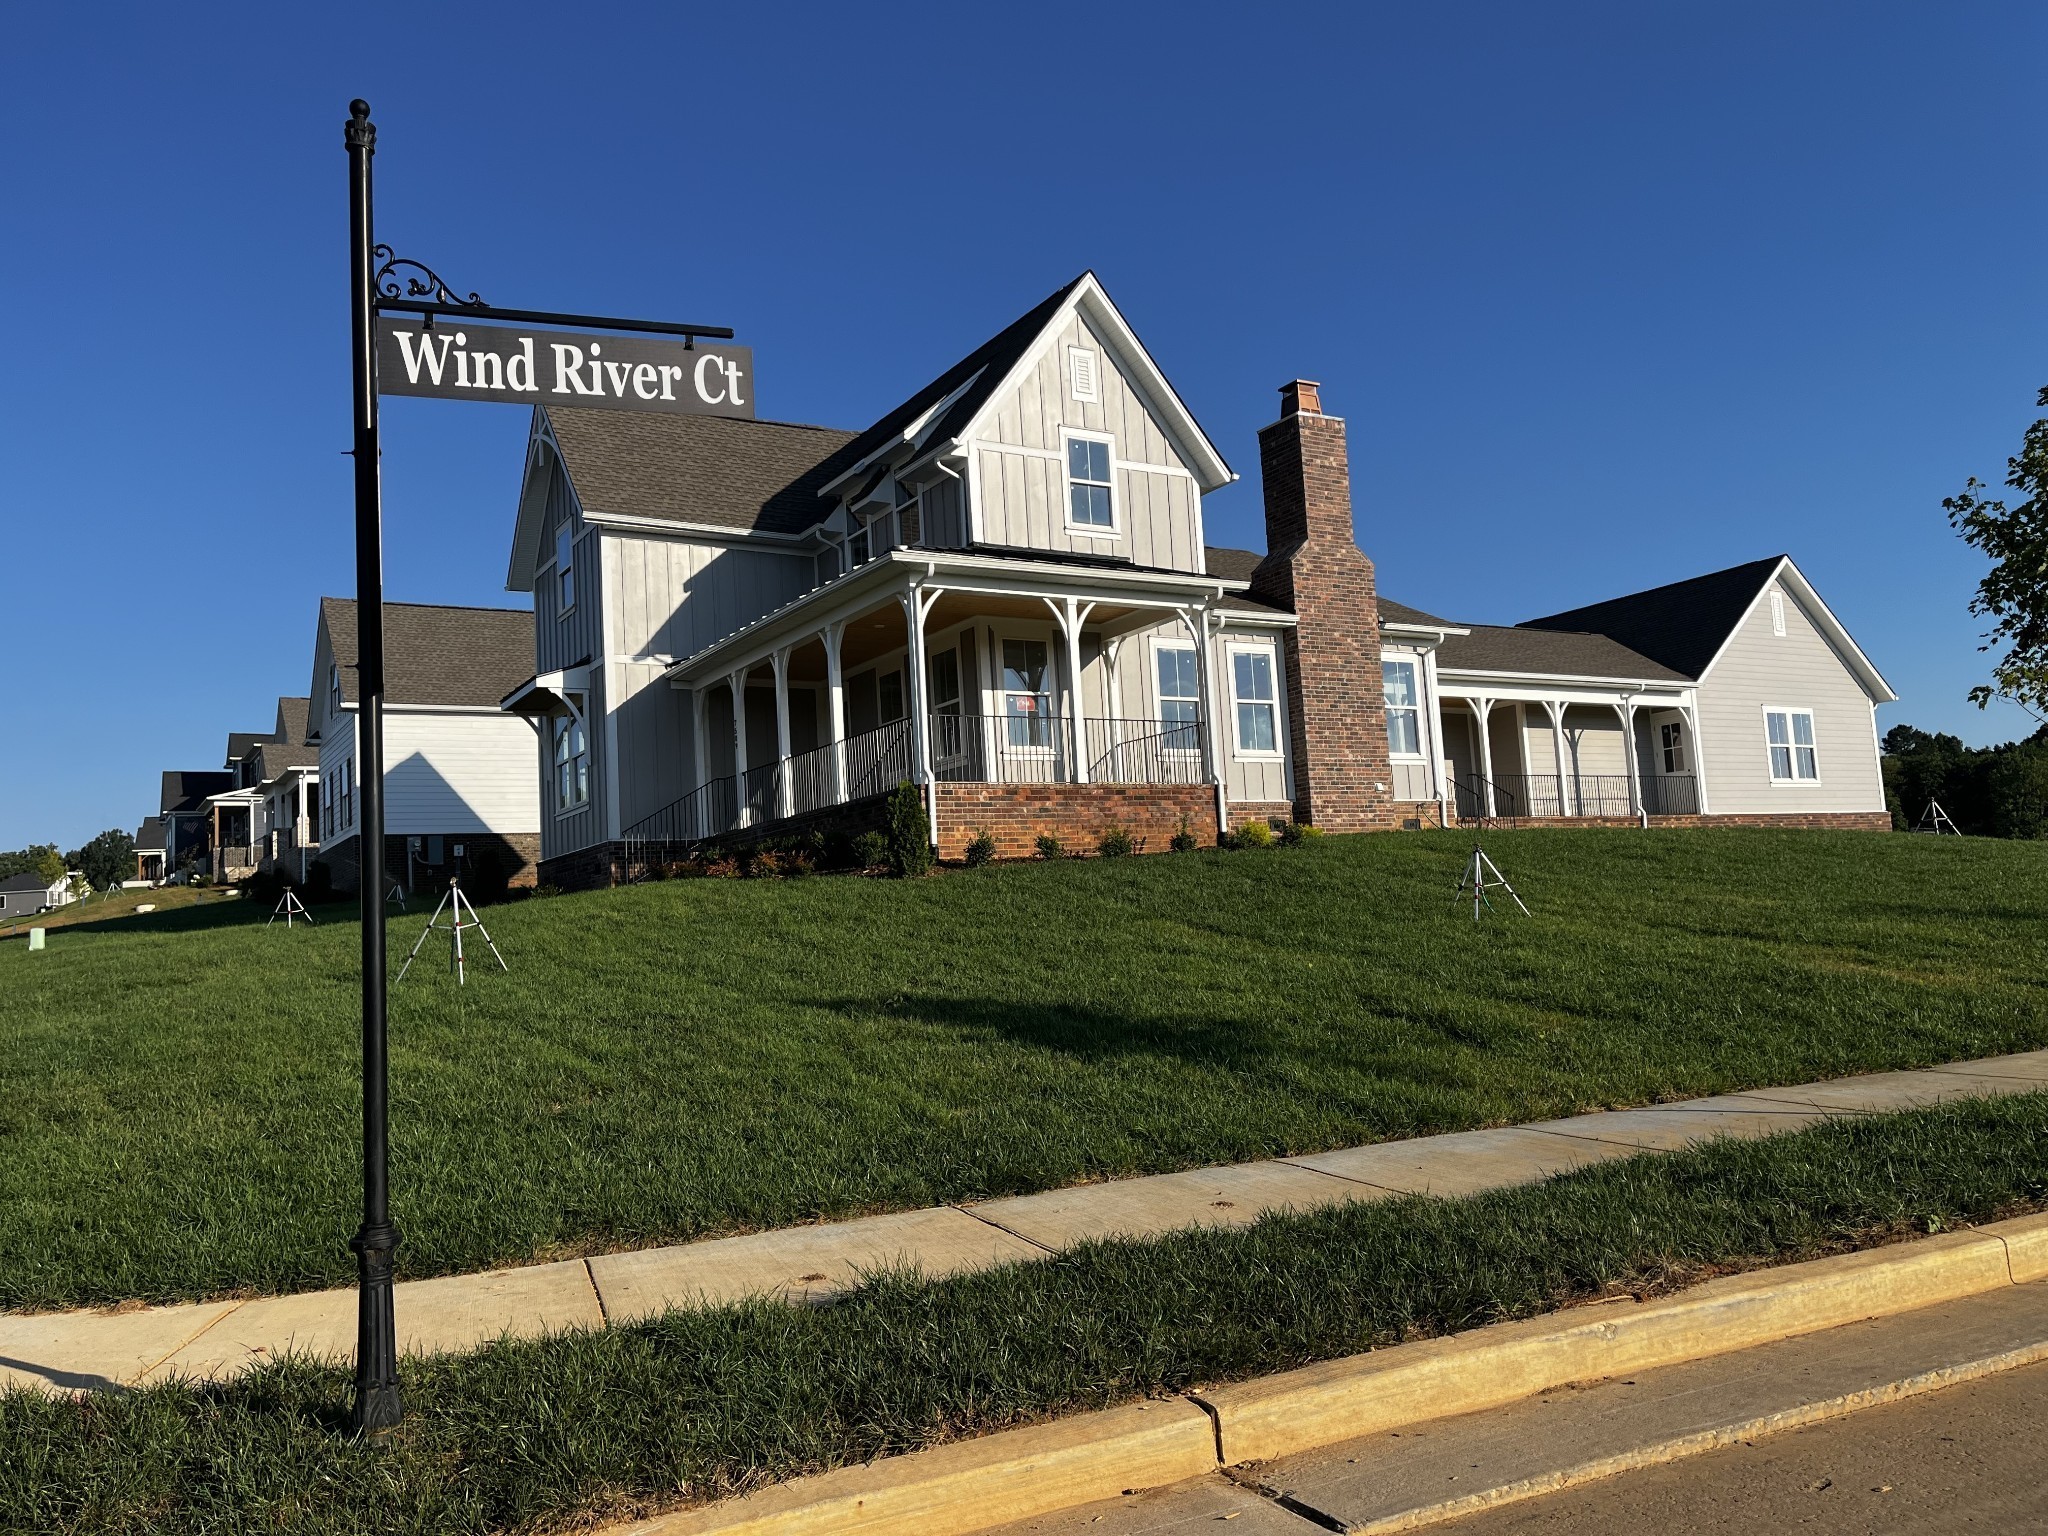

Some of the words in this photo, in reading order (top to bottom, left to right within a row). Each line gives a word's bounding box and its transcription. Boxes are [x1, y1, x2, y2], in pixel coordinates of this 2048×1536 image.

[392, 330, 540, 392] Wind
[550, 343, 683, 401] River
[693, 353, 745, 406] Ct
